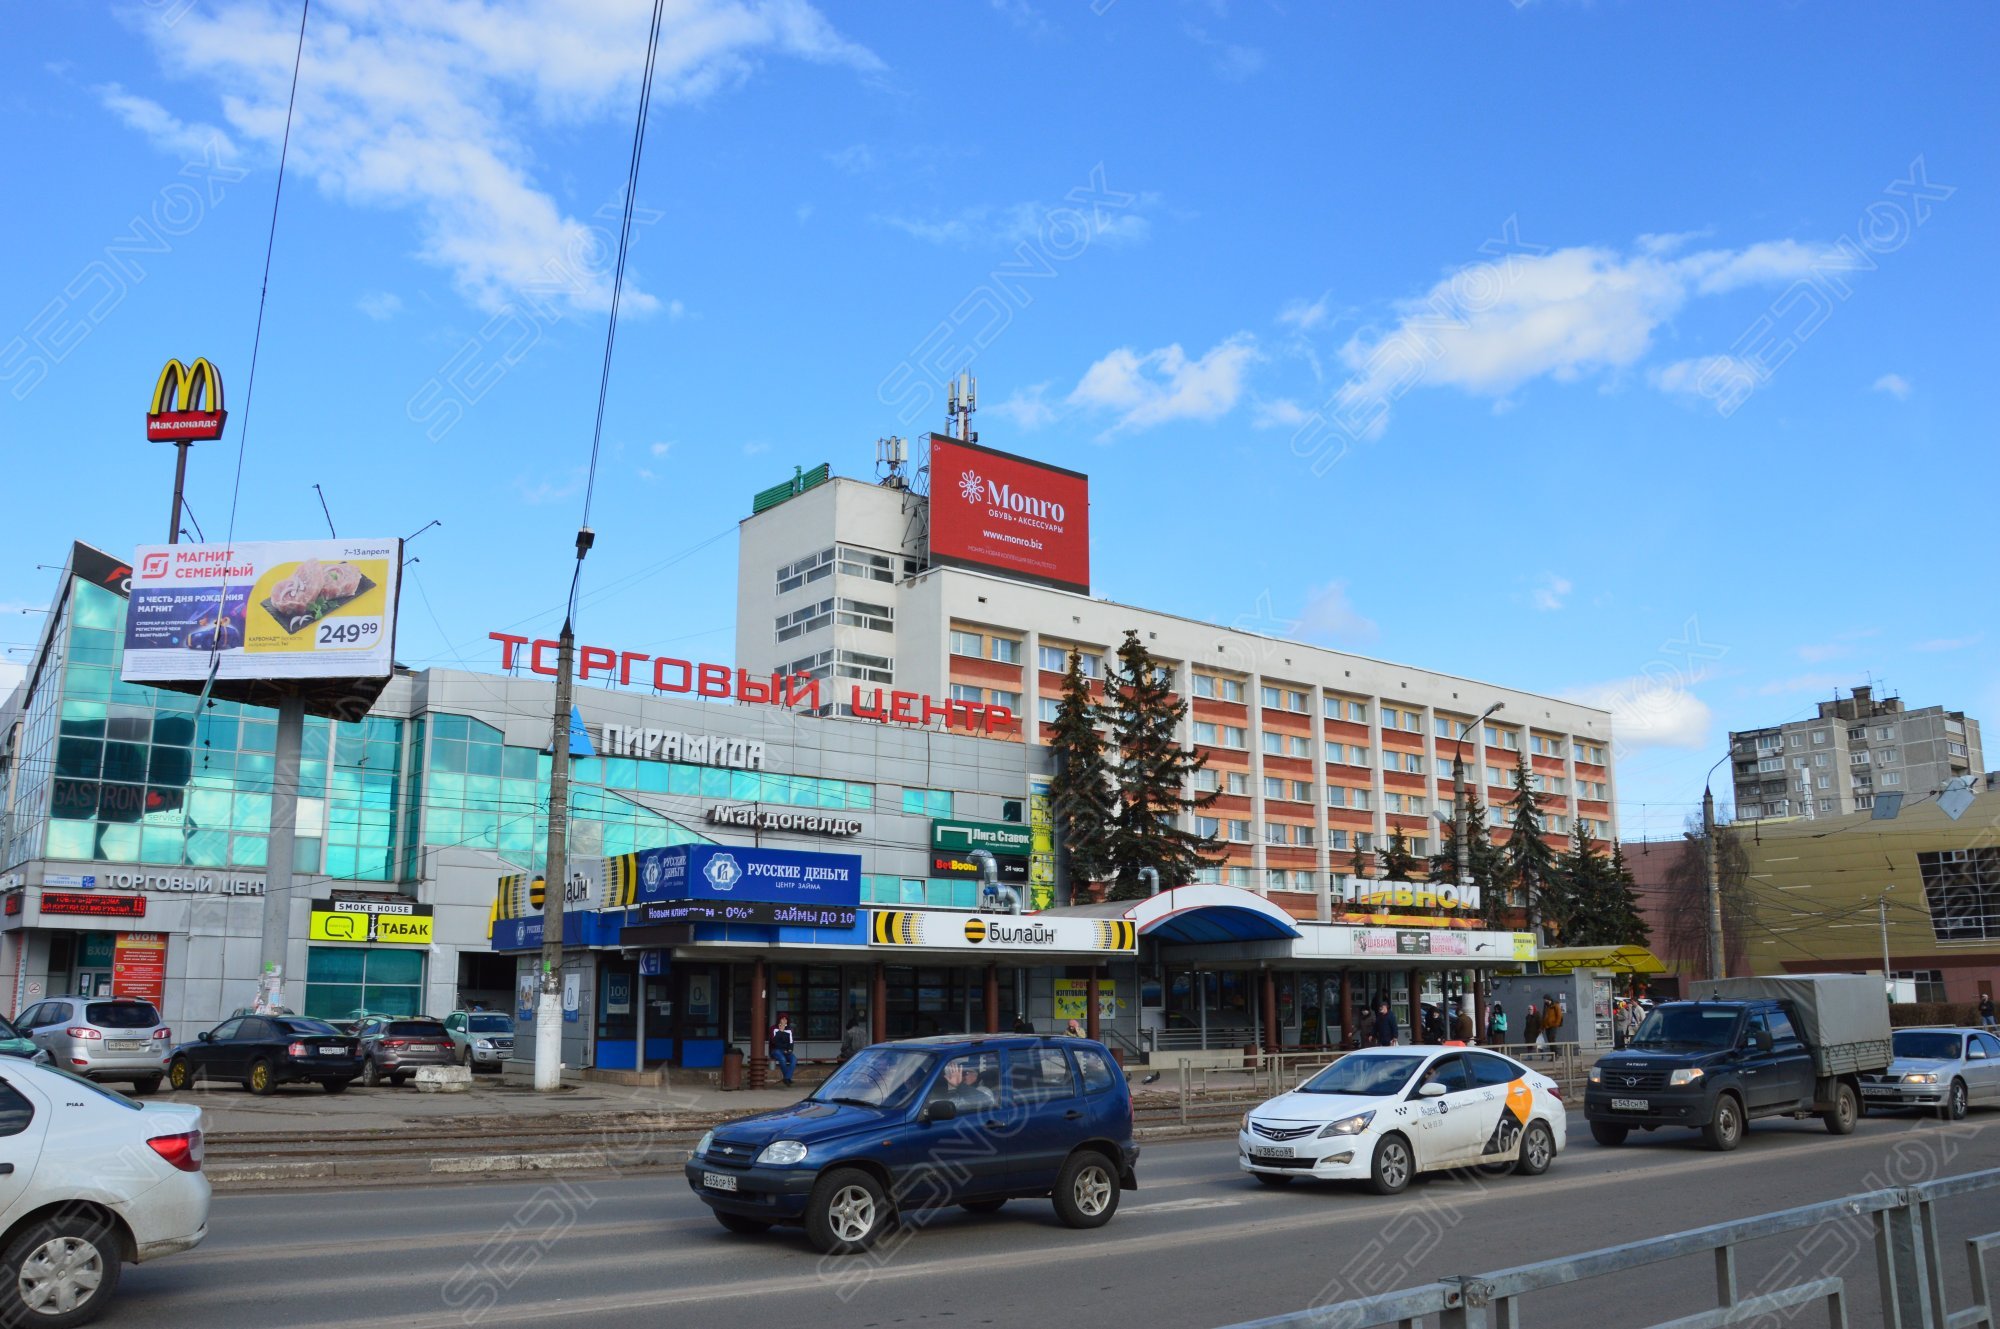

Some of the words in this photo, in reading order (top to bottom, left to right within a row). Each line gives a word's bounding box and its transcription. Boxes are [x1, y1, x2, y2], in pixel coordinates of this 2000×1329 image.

[149, 419, 218, 430] Макдоналдс
[986, 479, 1065, 523] Monro
[988, 508, 1013, 521] ОБУВЬ
[1018, 516, 1064, 533] АКСЕССУАРЫ
[983, 529, 1043, 550] www.monro.biz
[175, 550, 234, 563] МАГНИТ
[361, 549, 390, 557] апреля
[175, 563, 254, 579] СЕМЕЙНЫЙ
[146, 595, 172, 604] ЧЕСТЬ
[174, 595, 194, 604] ДНЯ
[137, 605, 174, 613] МАГНИТ
[319, 624, 361, 644] 249
[489, 631, 820, 711] ТОРГОВЫЙ
[851, 683, 1013, 734] ЦЕНТР
[600, 722, 766, 770] ПИРАМИДА
[713, 803, 862, 836] Макдоналдс
[972, 828, 997, 842] Лига
[997, 830, 1030, 845] Ставок
[747, 862, 801, 879] РУССКИЕ
[803, 866, 850, 882] ДЕНЬГИ
[935, 859, 978, 872] BetBoom
[105, 873, 213, 892] ТОРГОВЫЙ
[775, 881, 796, 889] ЦЕНТР
[797, 882, 821, 890] ЗАЙМА
[1343, 876, 1481, 910] ПИВНОЙ
[338, 903, 373, 912] SMOKE
[377, 905, 409, 914] HOUSE
[773, 907, 818, 923] ЗАЙМЫ
[819, 911, 837, 925] ДО
[127, 933, 158, 941] AVON
[381, 922, 429, 936] ТАБАК
[988, 922, 1055, 944] Билайн
[1367, 938, 1396, 948] ШАВАРМА
[609, 985, 629, 997] 100
[1498, 1119, 1520, 1153] Go
